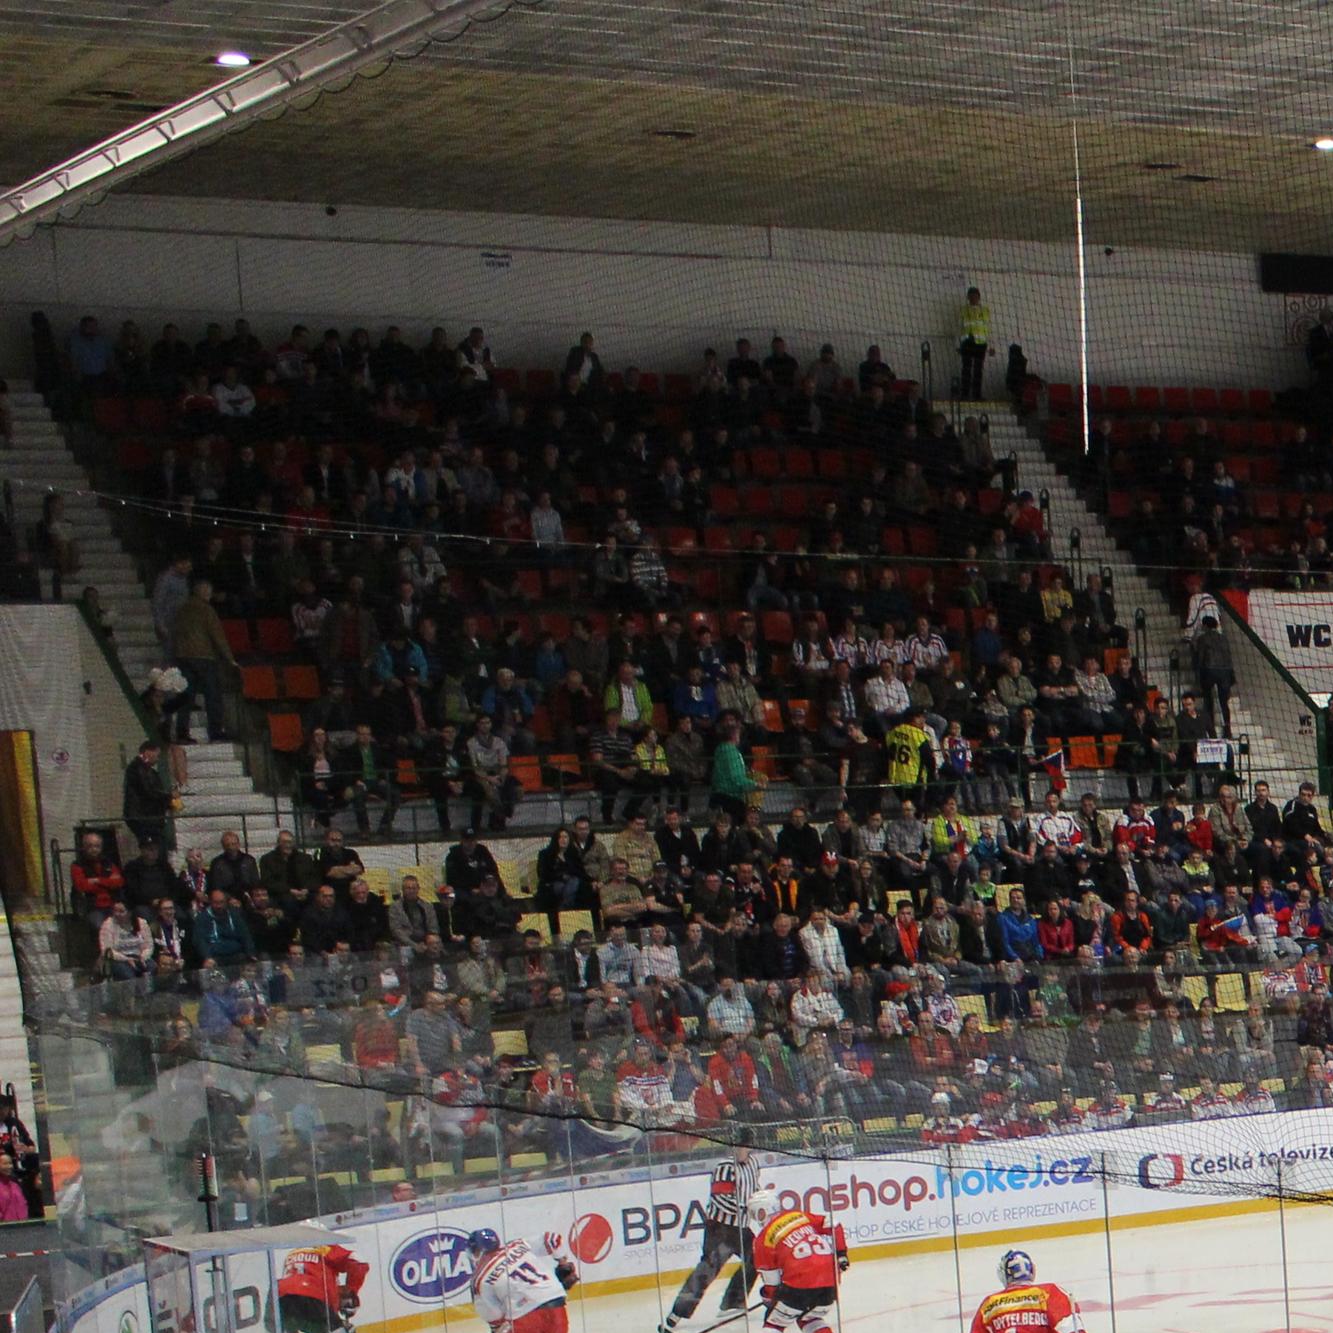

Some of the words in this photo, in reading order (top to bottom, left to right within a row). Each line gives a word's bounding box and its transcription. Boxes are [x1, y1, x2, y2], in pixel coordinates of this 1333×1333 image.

[1286, 624, 1332, 649] WC
[1190, 1152, 1254, 1176] Česká
[765, 1155, 1095, 1213] anshop.hokej.cz
[621, 1199, 709, 1247] BPA
[882, 1215, 926, 1236] ČESKÉ
[1003, 1198, 1097, 1221] REPREZENTACE
[401, 1252, 473, 1287] OLMA
